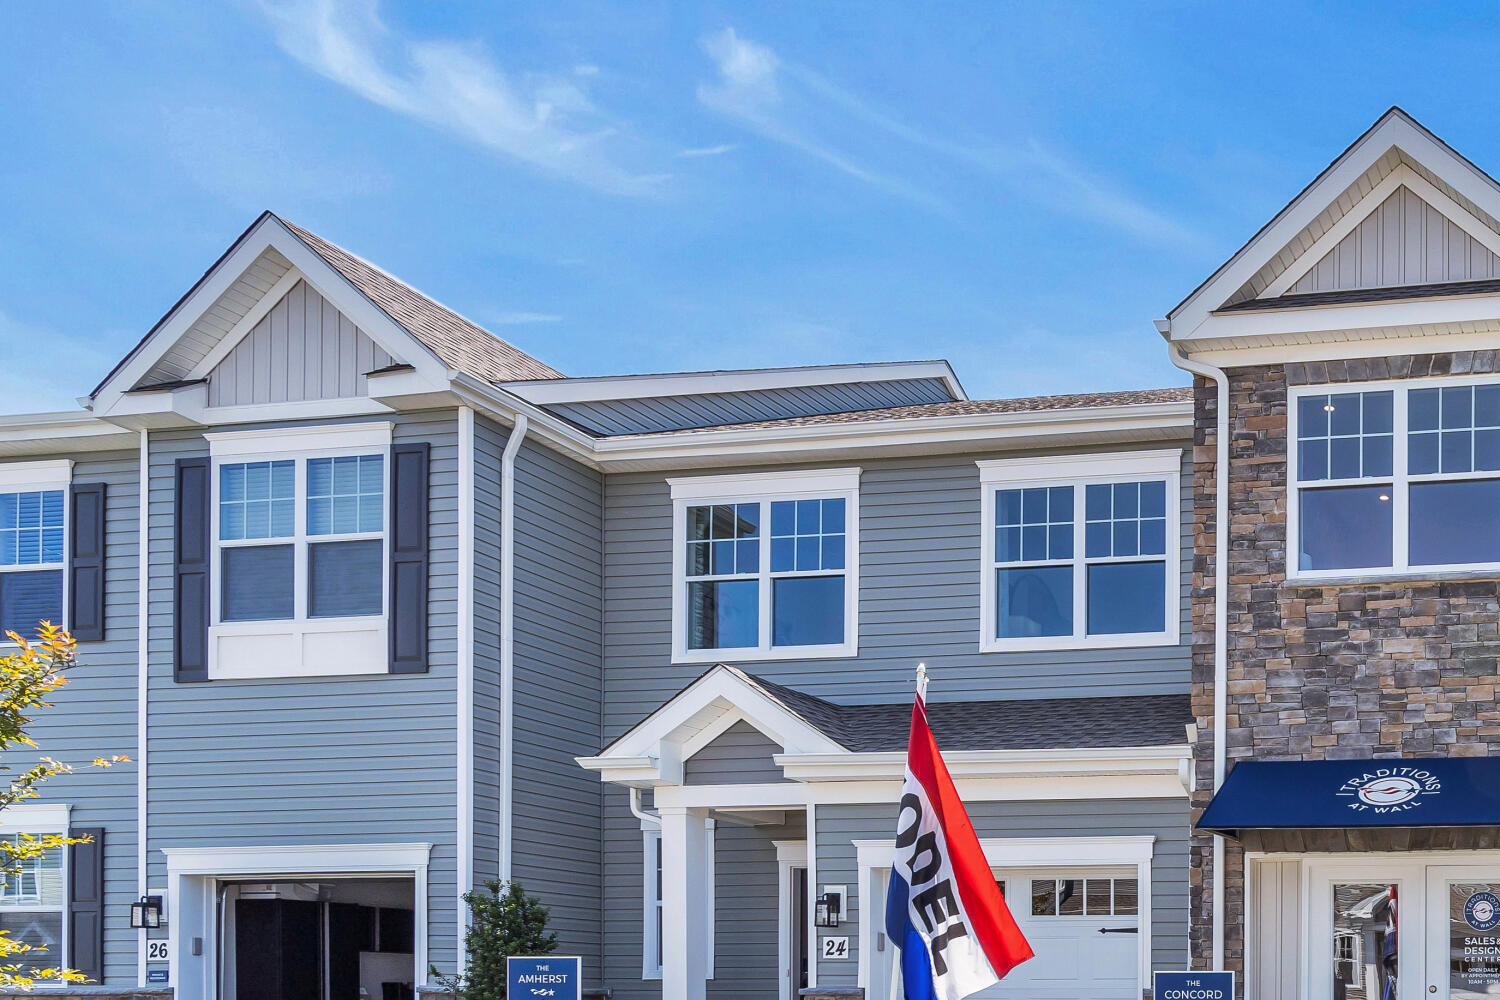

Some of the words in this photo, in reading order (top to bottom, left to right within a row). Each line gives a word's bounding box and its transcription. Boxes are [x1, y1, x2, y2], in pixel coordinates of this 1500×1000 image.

[1340, 767, 1441, 791] TRADITIONS
[1347, 803, 1369, 811] AT
[1374, 802, 1422, 813] WALL
[894, 777, 968, 977] ODEL
[1466, 894, 1500, 912] TRADITIONS
[149, 942, 168, 958] 26
[825, 939, 847, 956] 24
[536, 964, 550, 972] THE
[518, 974, 569, 984] AMHERST
[1185, 979, 1201, 987] THE
[1164, 989, 1223, 1000] CONCORD
